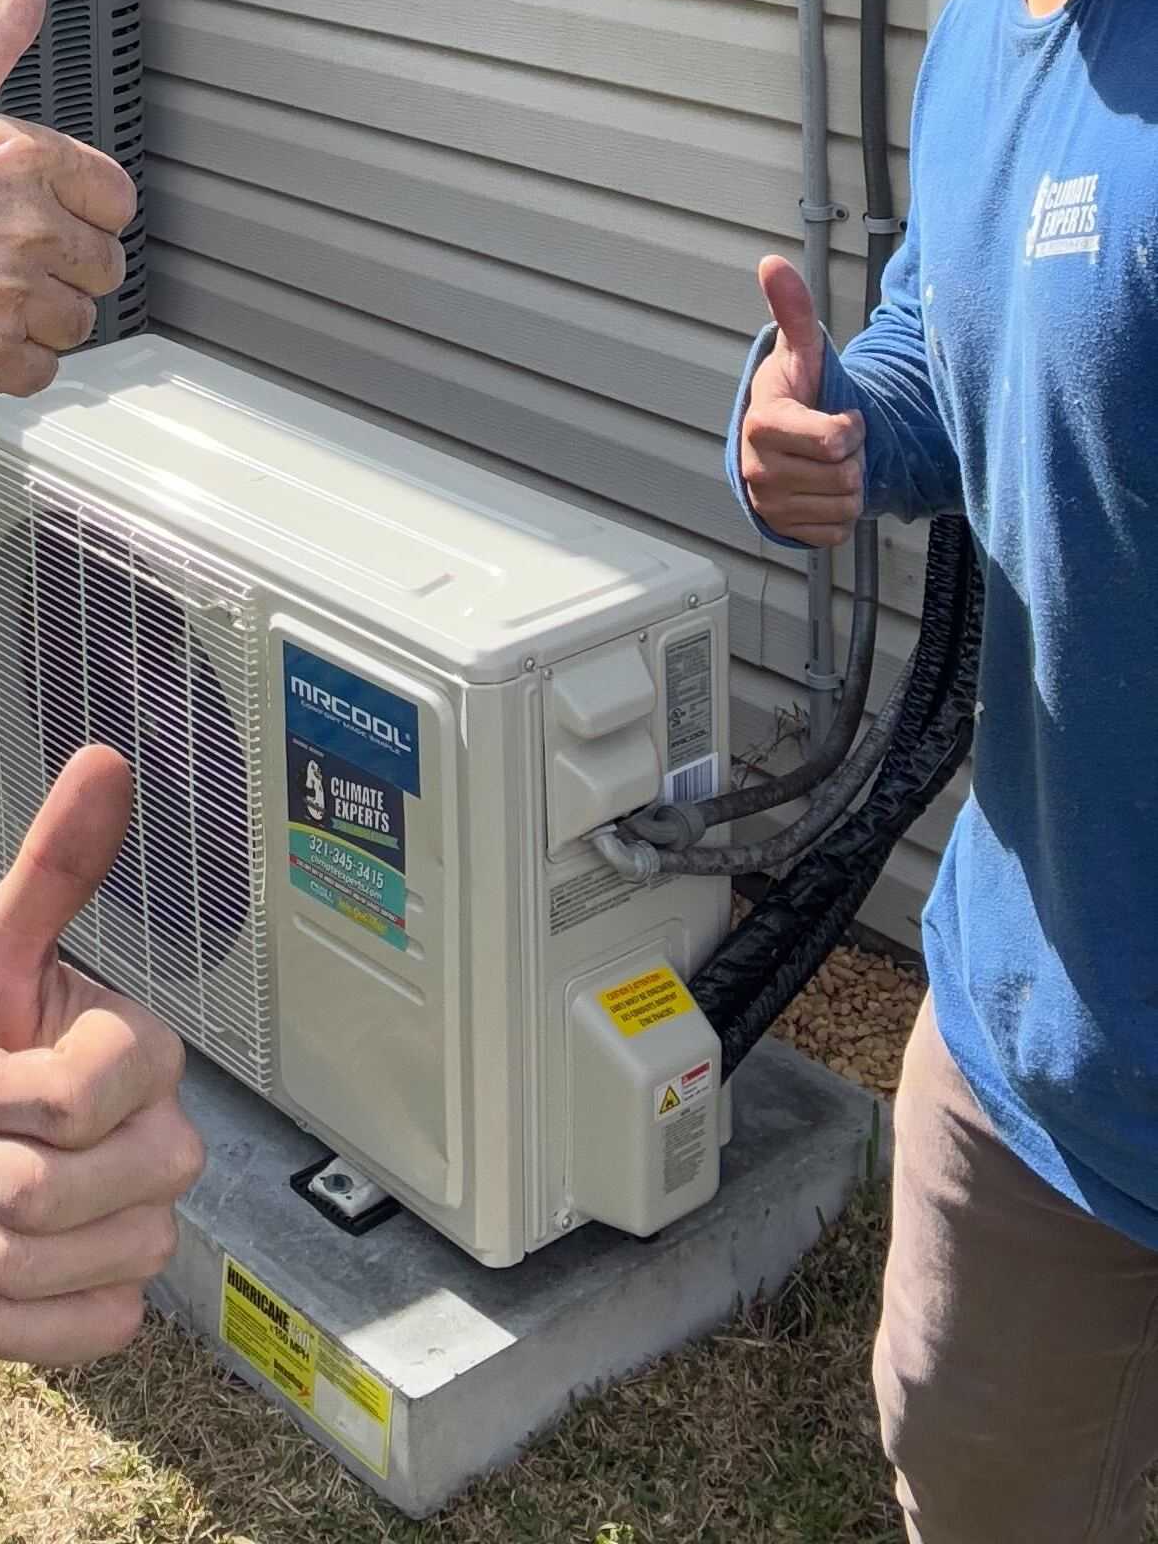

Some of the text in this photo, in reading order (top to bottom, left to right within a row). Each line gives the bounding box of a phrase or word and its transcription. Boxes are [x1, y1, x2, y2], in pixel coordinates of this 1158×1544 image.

[1044, 174, 1099, 210] CLIMATE
[1040, 204, 1098, 238] EXPERTS
[290, 676, 412, 753] MRCOOL
[330, 776, 384, 810] CLIMATE
[334, 798, 390, 833] EXPERTS
[309, 835, 384, 889] 321-345-3415
[228, 1265, 290, 1334] HURRICANE
